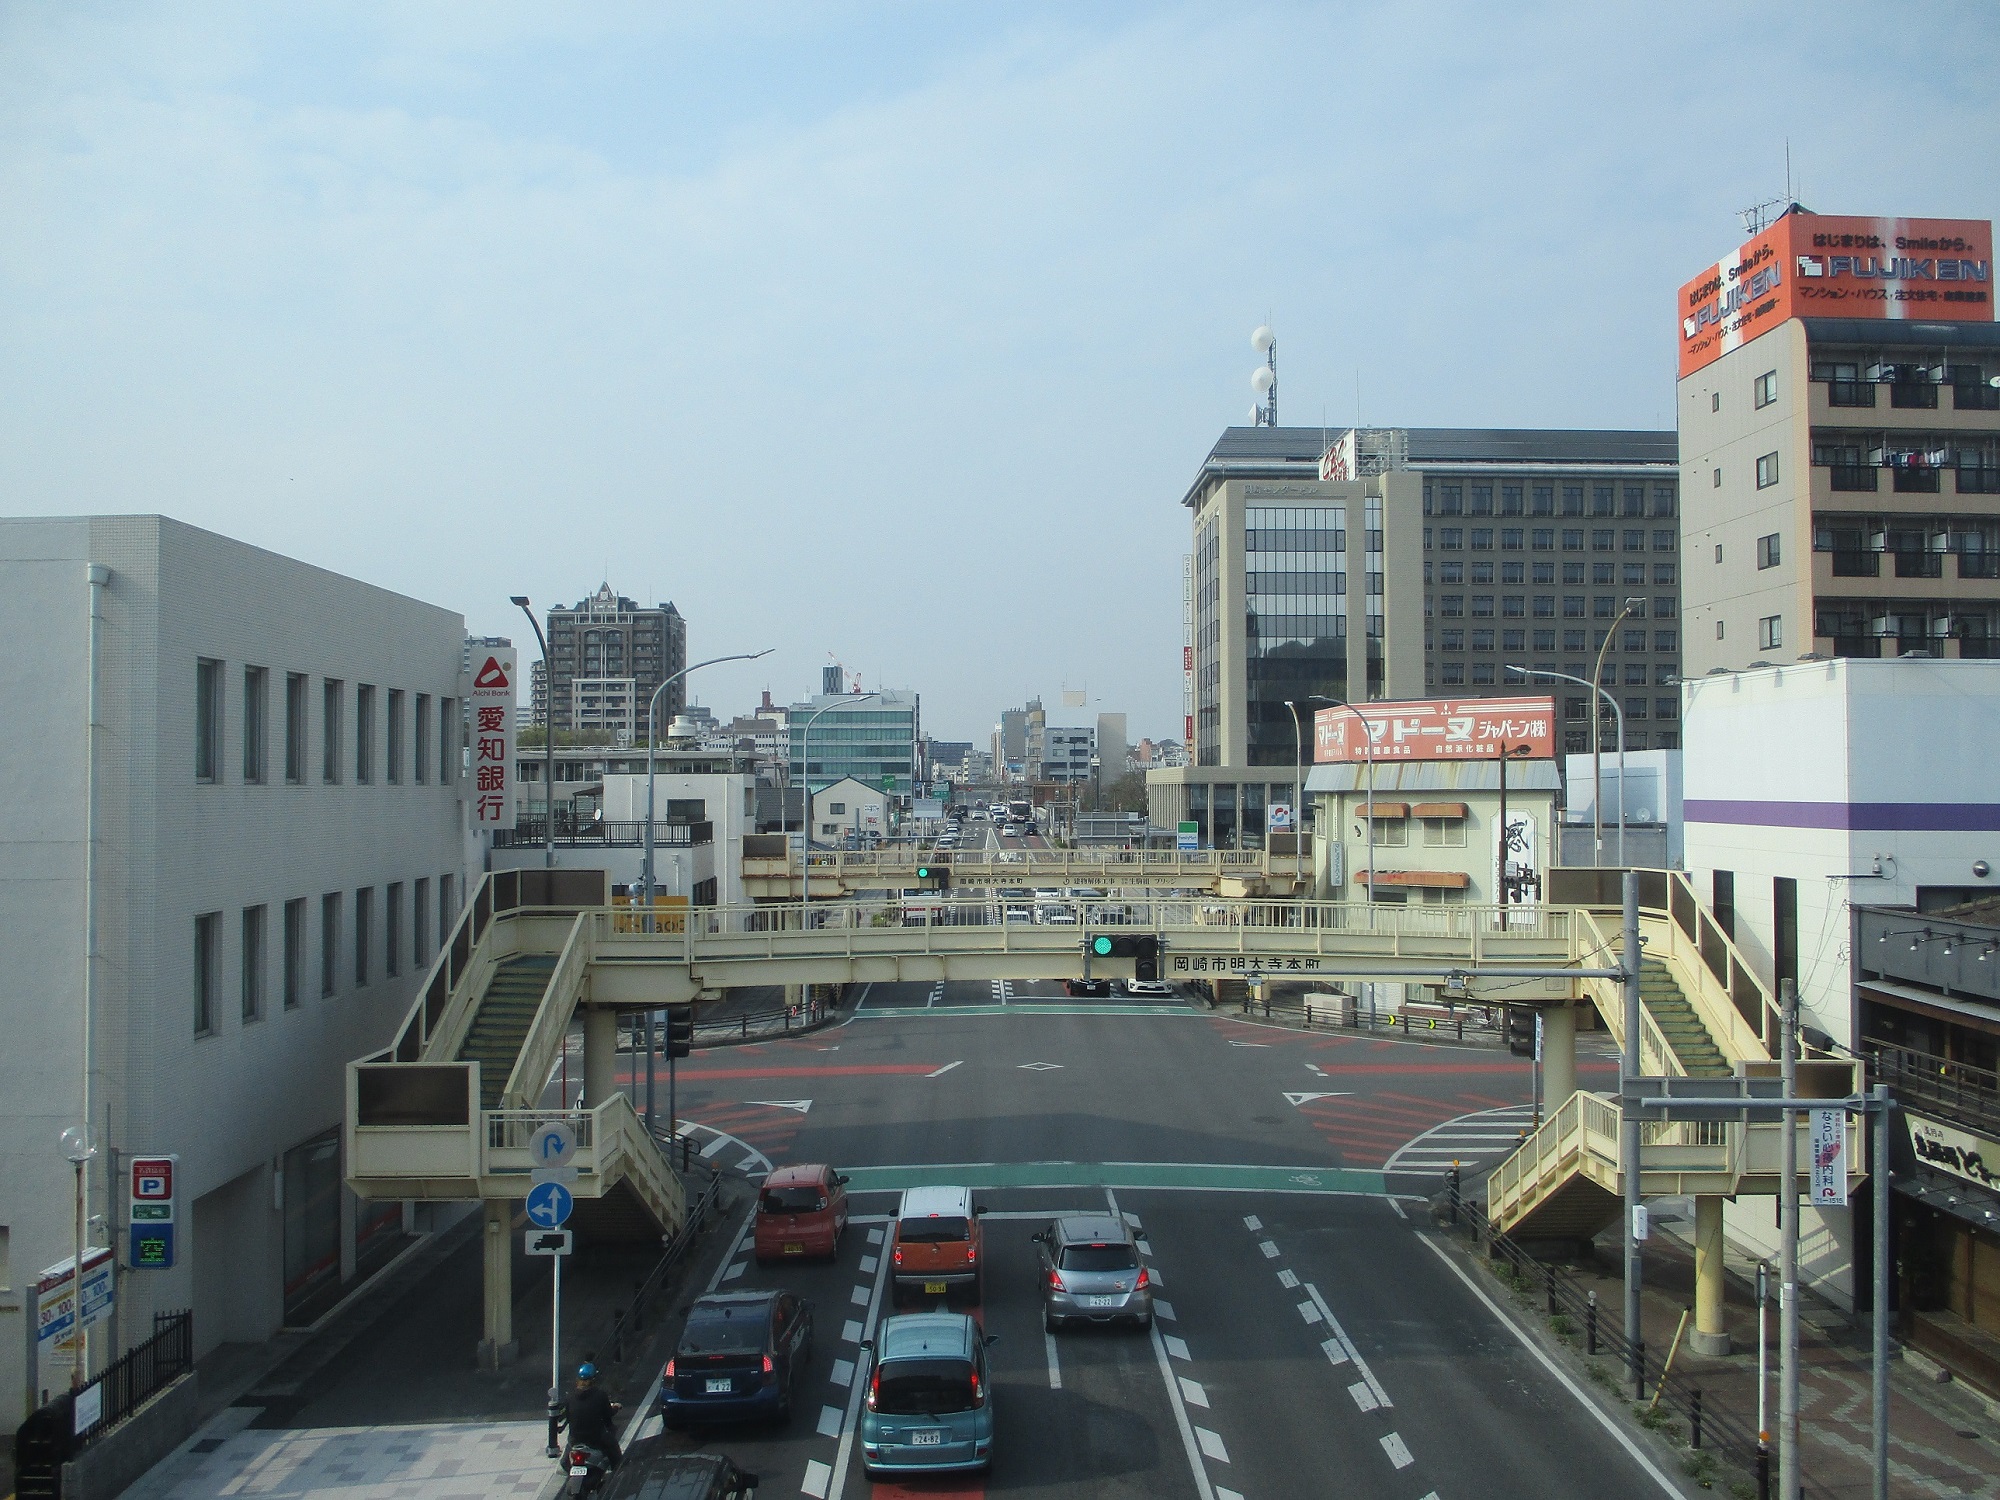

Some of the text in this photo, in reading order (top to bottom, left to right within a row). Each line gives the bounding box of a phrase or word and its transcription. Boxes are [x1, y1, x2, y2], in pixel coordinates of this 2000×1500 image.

[1828, 256, 1988, 282] FUJIKEN
[1695, 260, 1782, 332] FUJIKEN
[1322, 439, 1345, 480] CBC
[1318, 722, 1345, 747] マドーヌ
[1361, 717, 1475, 743] マドーヌ
[1436, 744, 1494, 753] 自然派化粧品
[477, 706, 505, 821] 愛知銀行
[1174, 956, 1321, 972] 岡崎市明大寺本町
[143, 1179, 160, 1193] P
[918, 1435, 940, 1443] 24-82
